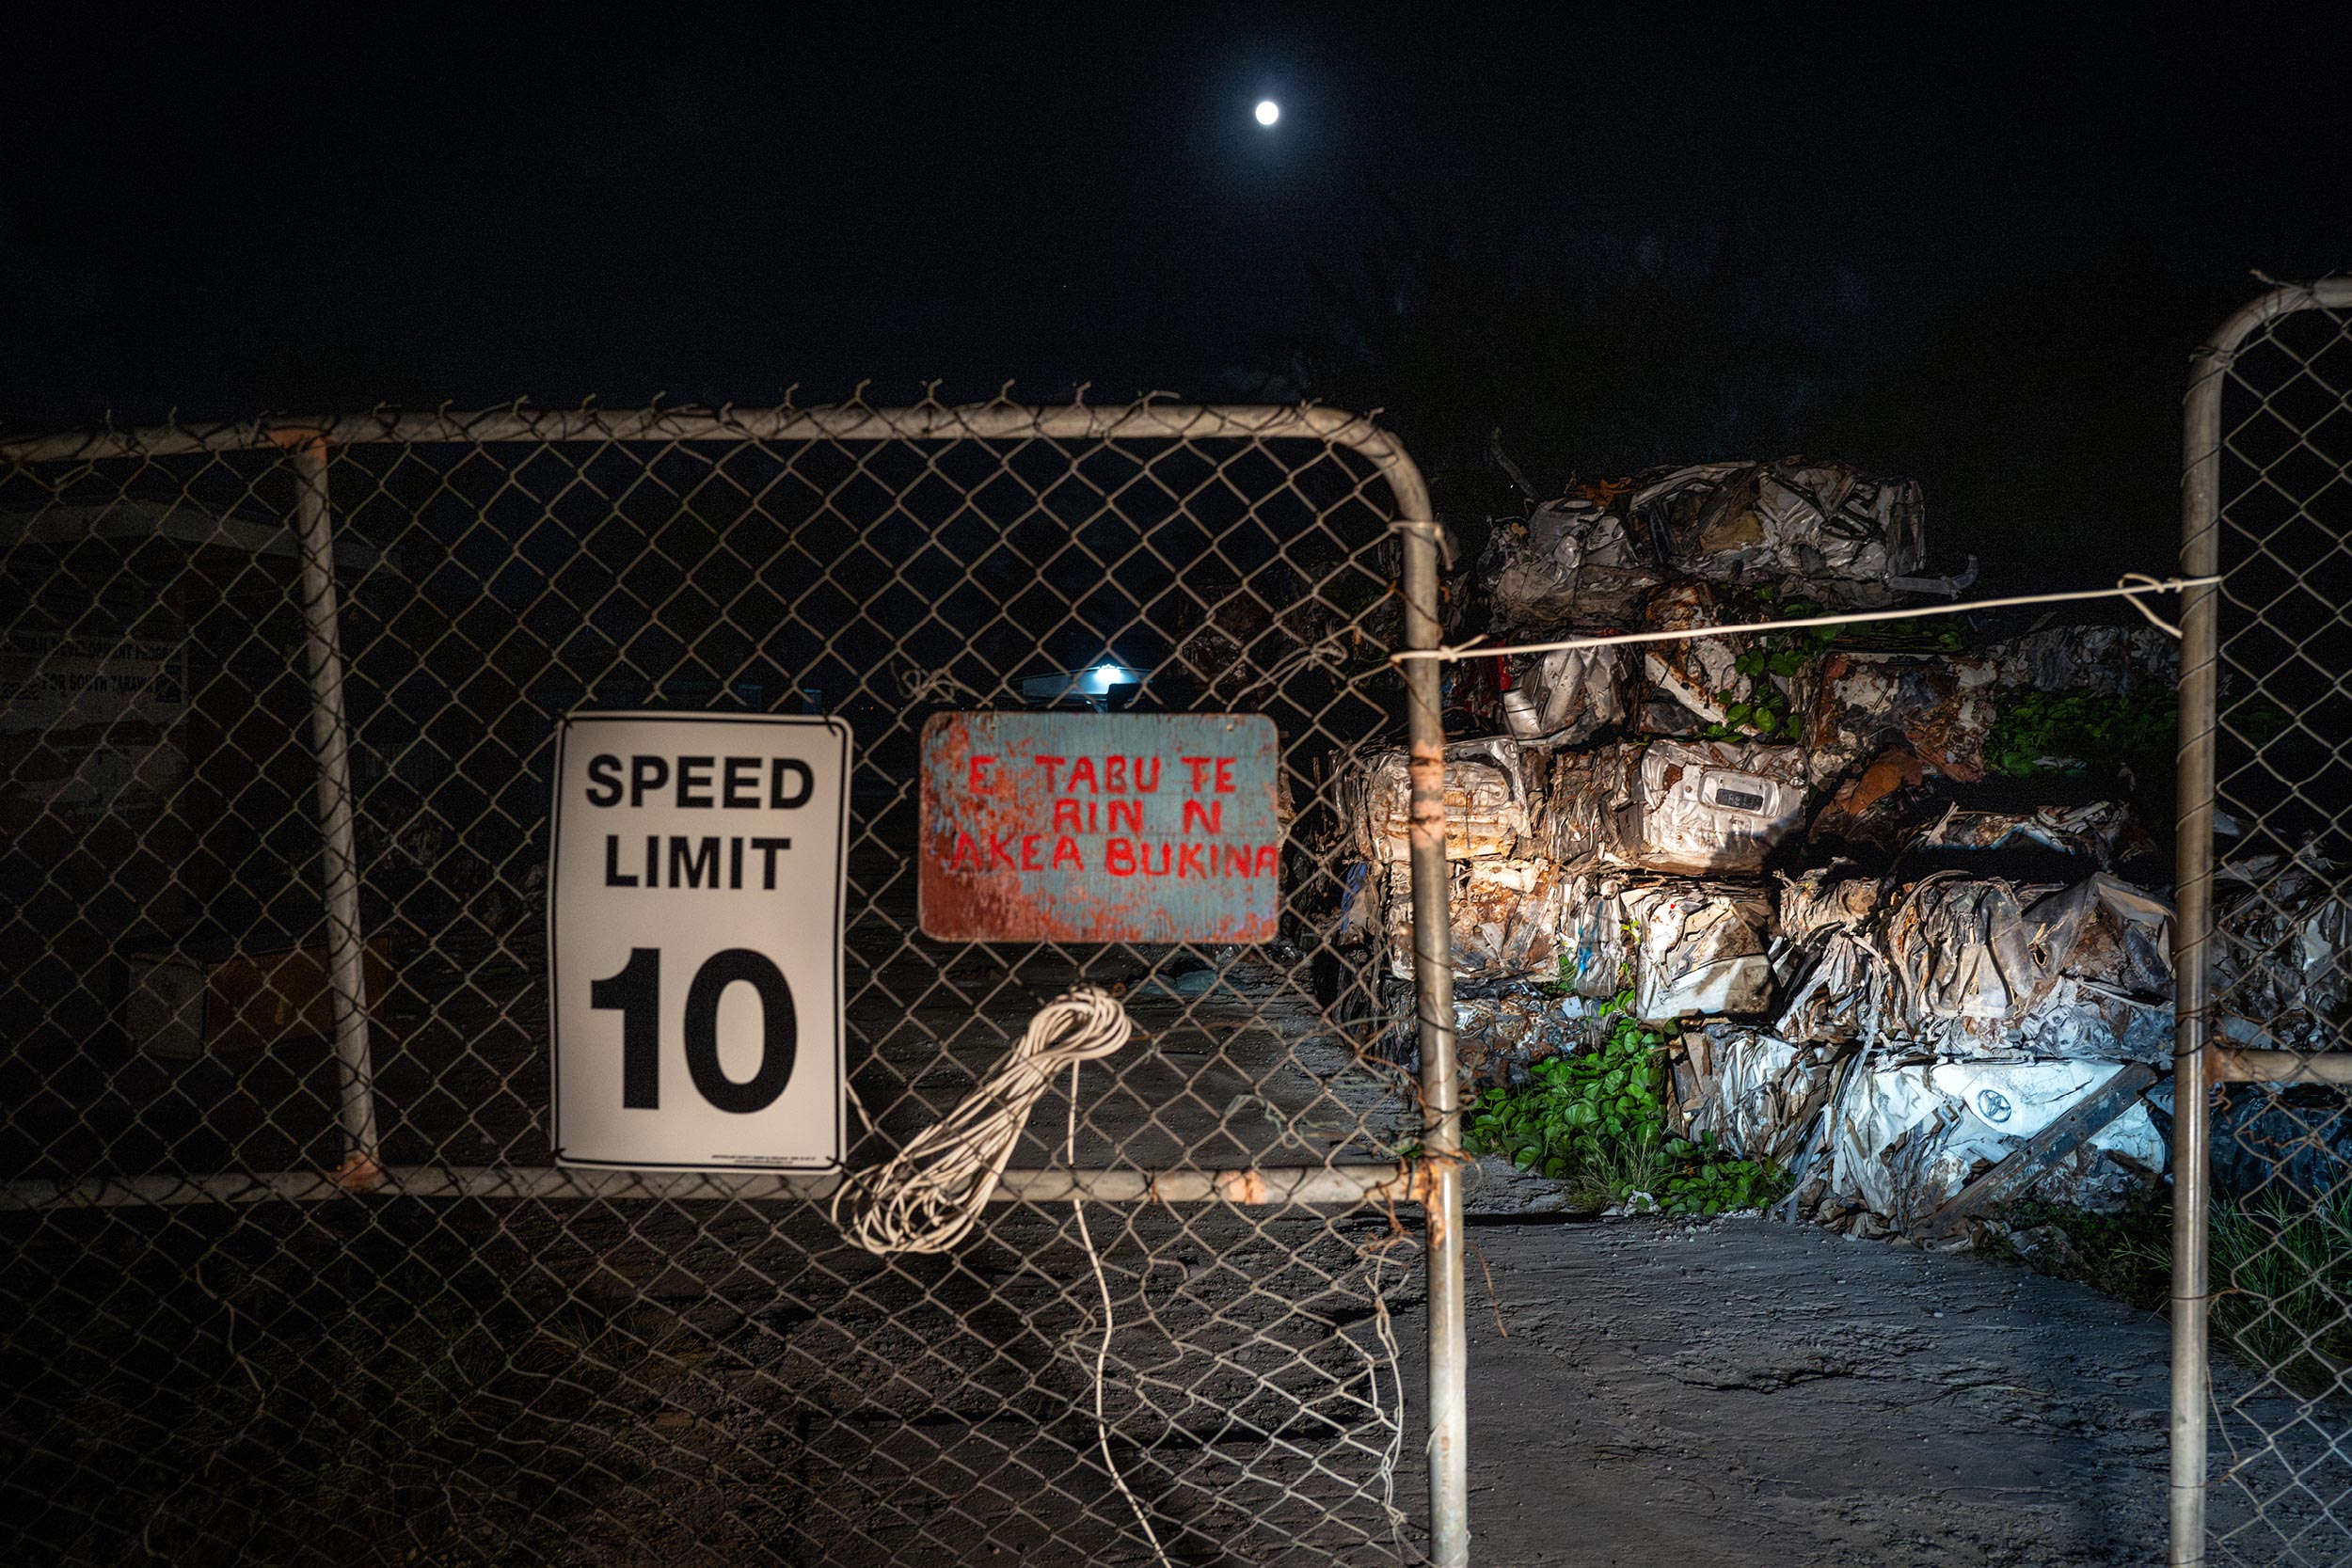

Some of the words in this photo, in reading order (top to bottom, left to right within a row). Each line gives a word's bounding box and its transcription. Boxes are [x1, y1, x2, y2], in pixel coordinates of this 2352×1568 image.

[42, 673, 66, 692] FOR
[70, 673, 107, 693] SOUTH
[585, 753, 815, 810] SPEED
[969, 755, 996, 794] E
[1035, 754, 1161, 794] TABU
[1180, 756, 1237, 794] TE
[1053, 799, 1144, 835] RIN
[1182, 800, 1221, 835] N
[605, 834, 791, 890] LIMIT
[949, 832, 1084, 872] AKEA
[1105, 838, 1279, 879] BUKINA
[590, 947, 798, 1115] 10
